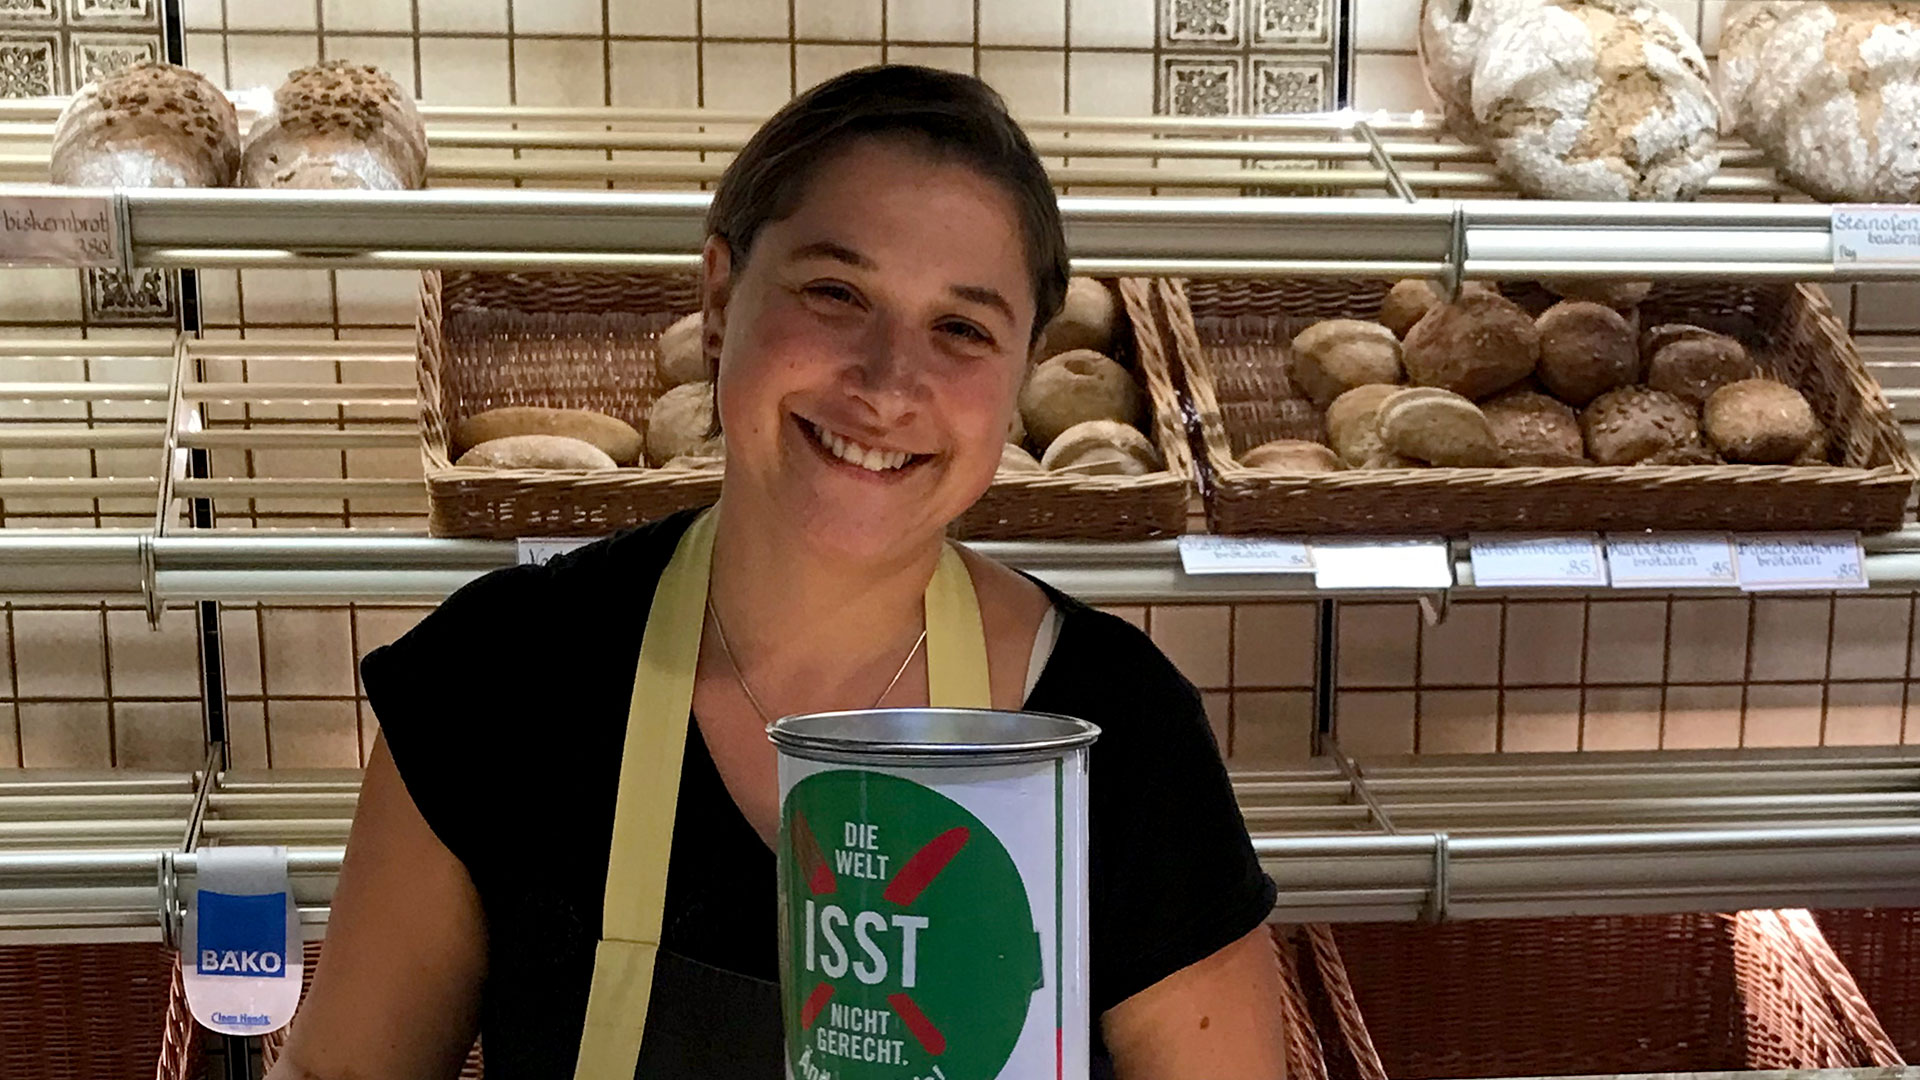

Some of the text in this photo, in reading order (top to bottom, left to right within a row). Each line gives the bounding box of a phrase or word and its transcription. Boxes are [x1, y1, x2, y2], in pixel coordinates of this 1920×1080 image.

[844, 821, 879, 850] DIE
[835, 849, 889, 880] WELT
[805, 900, 929, 988] ISST
[201, 949, 282, 973] BÄKO
[830, 1003, 891, 1035] NICHT
[816, 1027, 909, 1066] GERECHT.
